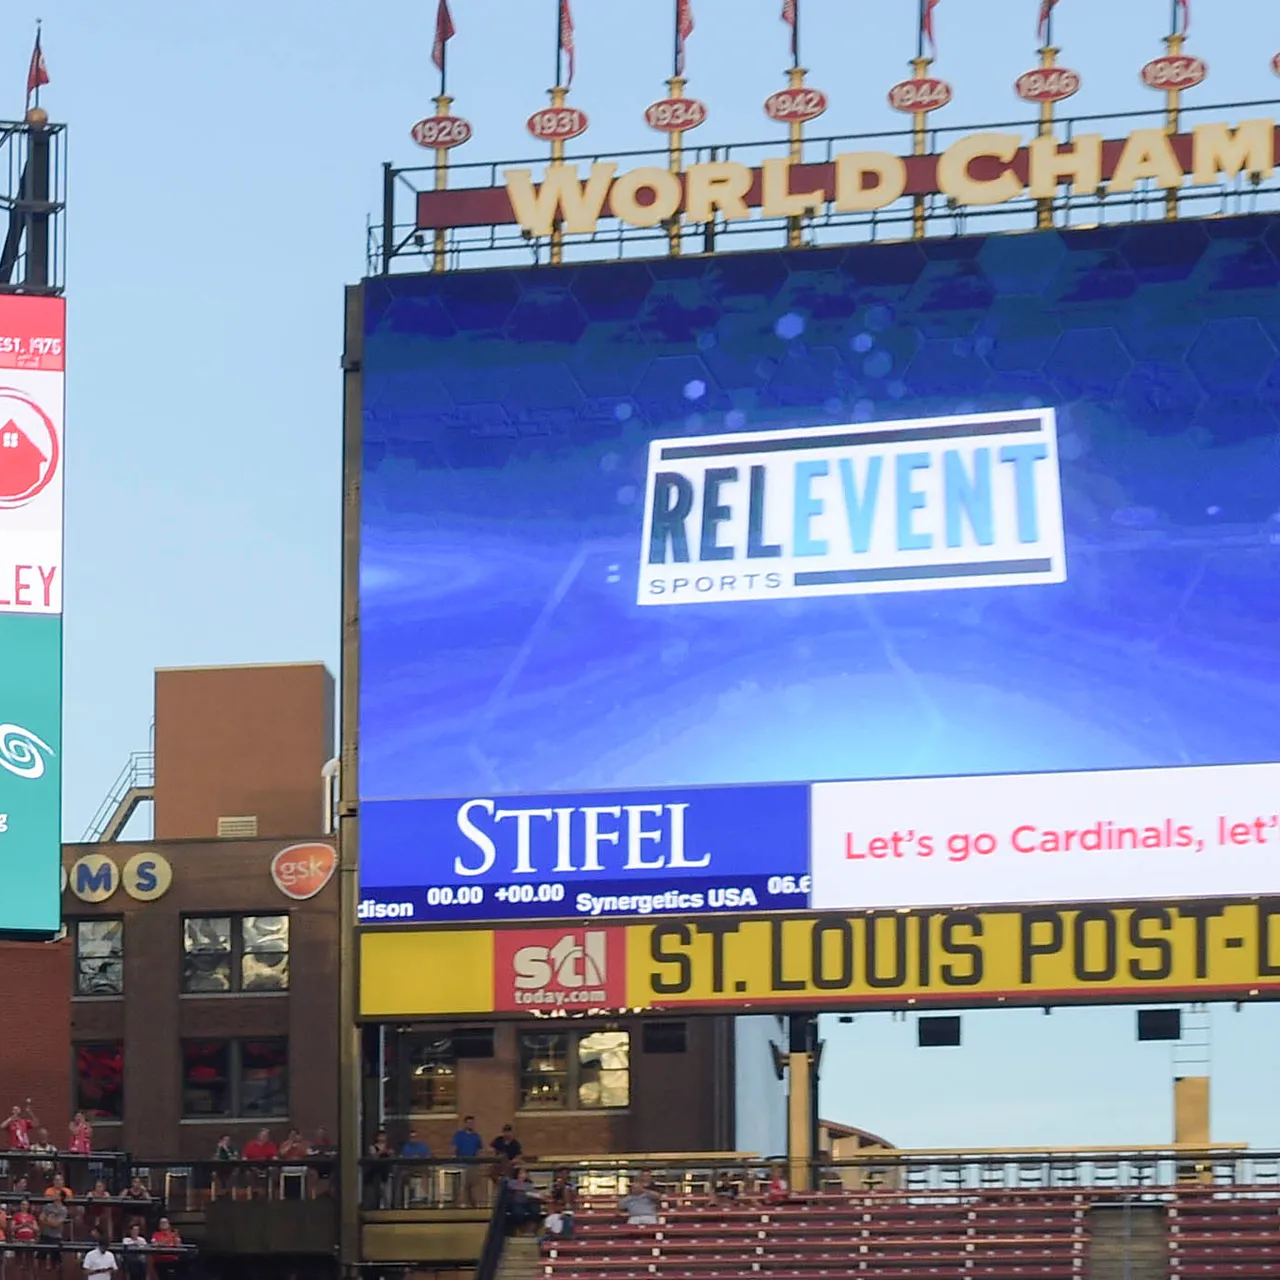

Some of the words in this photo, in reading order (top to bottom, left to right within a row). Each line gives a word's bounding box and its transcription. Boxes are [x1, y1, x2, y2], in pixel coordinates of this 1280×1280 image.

[1018, 71, 1077, 96] 1946
[1144, 60, 1203, 86] 1964
[768, 92, 822, 118] 1942
[891, 81, 948, 108] 1944
[531, 110, 586, 136] 1931
[648, 102, 703, 127] 1934
[414, 120, 470, 144] 1926
[504, 152, 907, 236] WORLD
[936, 118, 1276, 205] CHAM
[648, 442, 1048, 565] RELEVENT
[648, 572, 783, 595] SPORTS
[453, 798, 711, 877] STIFEL
[845, 829, 934, 860] Let's
[947, 831, 997, 863] go
[1011, 818, 1205, 855] Cardinals,
[279, 855, 326, 886] gsk
[426, 885, 484, 906] 00.00
[494, 884, 565, 905] +00.00
[576, 889, 705, 917] Synergetics
[708, 887, 758, 909] USA
[650, 922, 747, 995] ST.
[771, 908, 984, 991] LOUIS
[514, 988, 607, 1006] today.com
